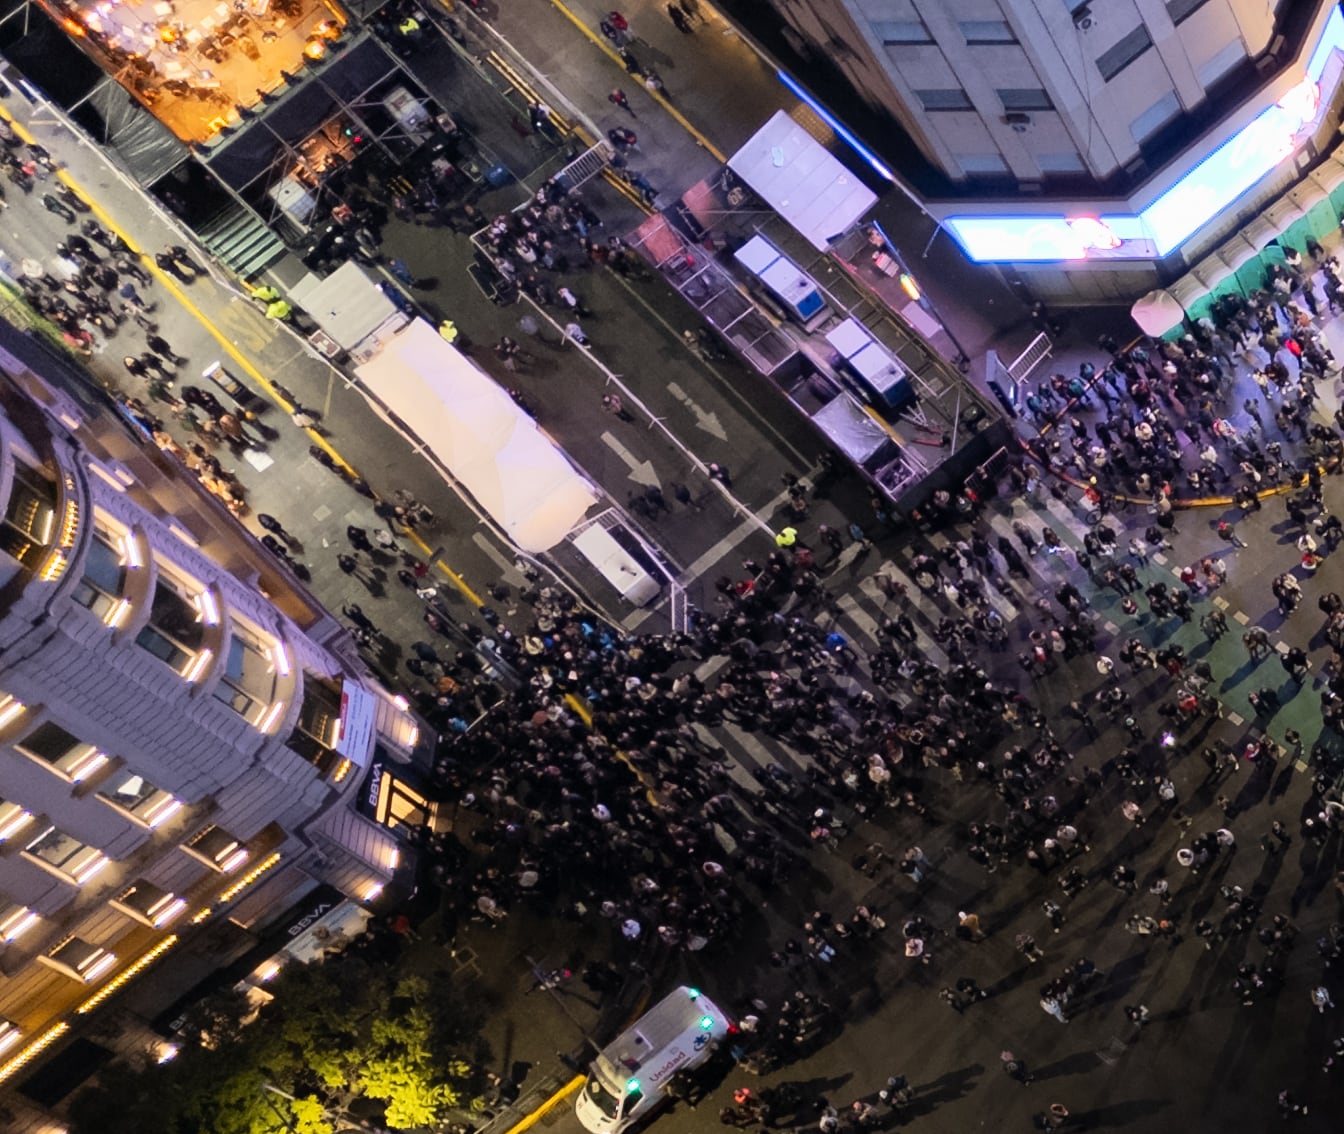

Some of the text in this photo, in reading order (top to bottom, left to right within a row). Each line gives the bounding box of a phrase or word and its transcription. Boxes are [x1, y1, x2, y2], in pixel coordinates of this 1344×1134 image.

[368, 762, 383, 807] BBVA
[288, 903, 332, 937] BBVA
[649, 1050, 686, 1083] Unidad
